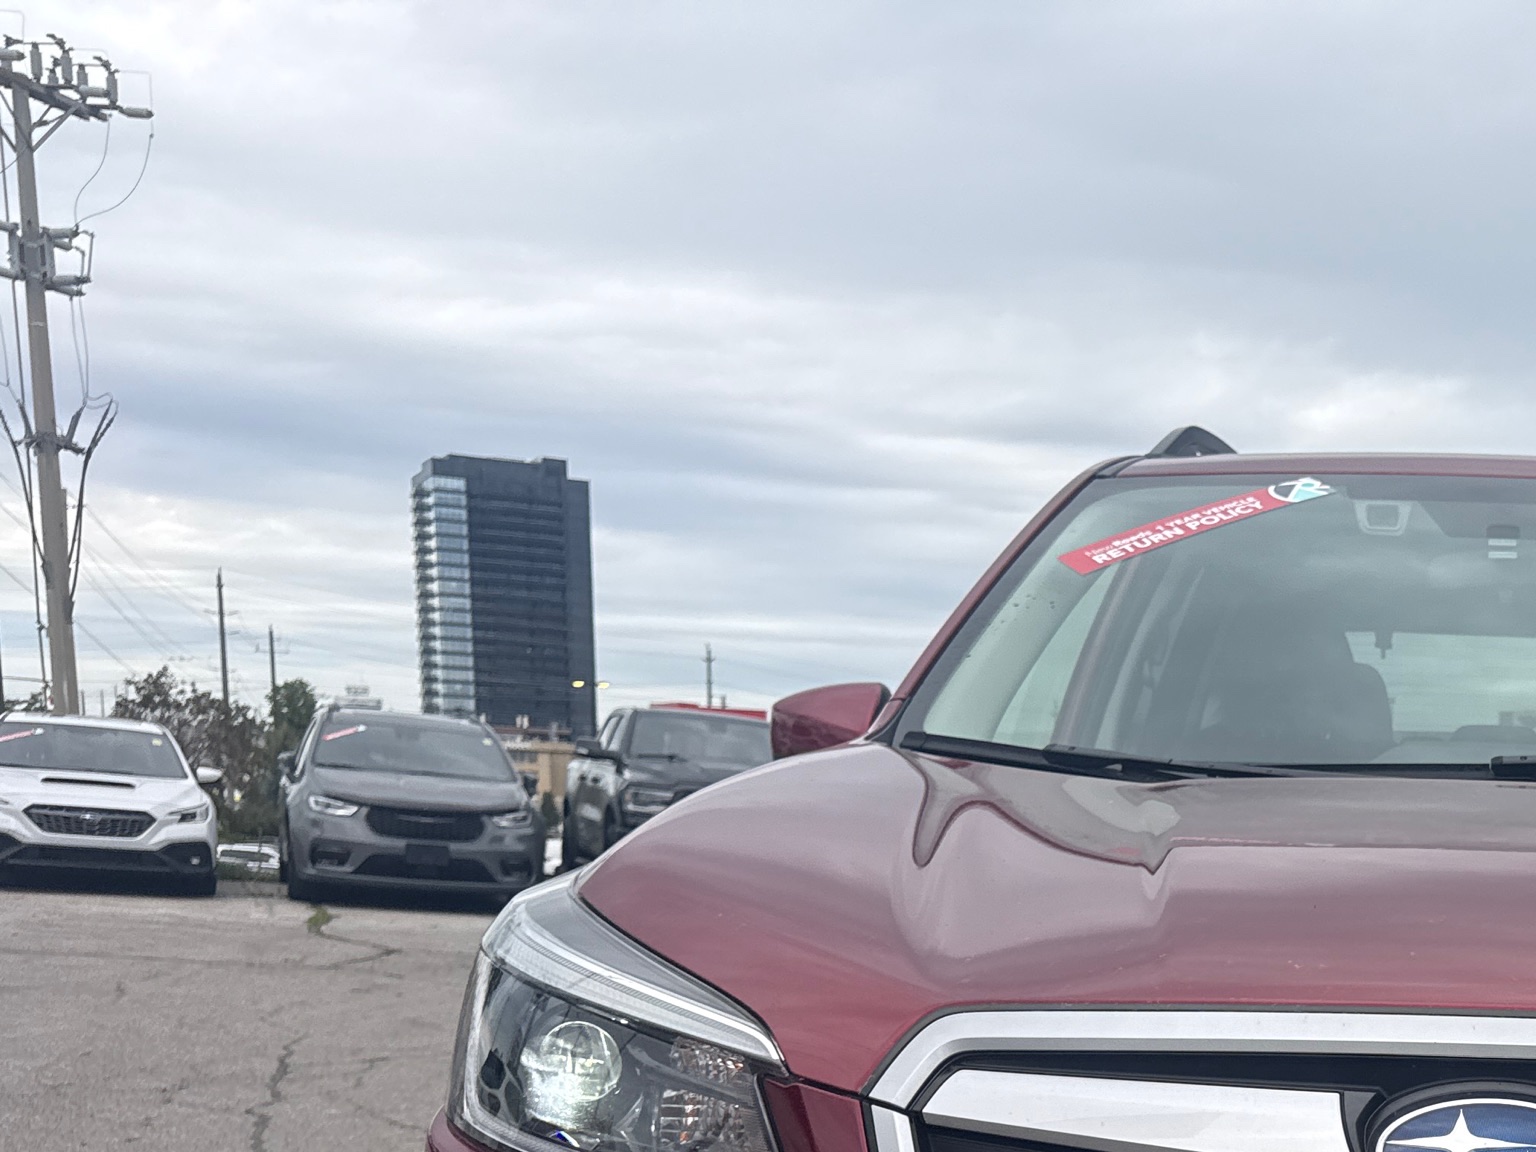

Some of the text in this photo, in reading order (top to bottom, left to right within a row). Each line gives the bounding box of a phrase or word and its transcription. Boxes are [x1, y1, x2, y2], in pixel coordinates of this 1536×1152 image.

[1091, 501, 1264, 564] RETURN POLICY
[1165, 513, 1202, 528] YEAR
[1202, 497, 1257, 516] VEHICLE
